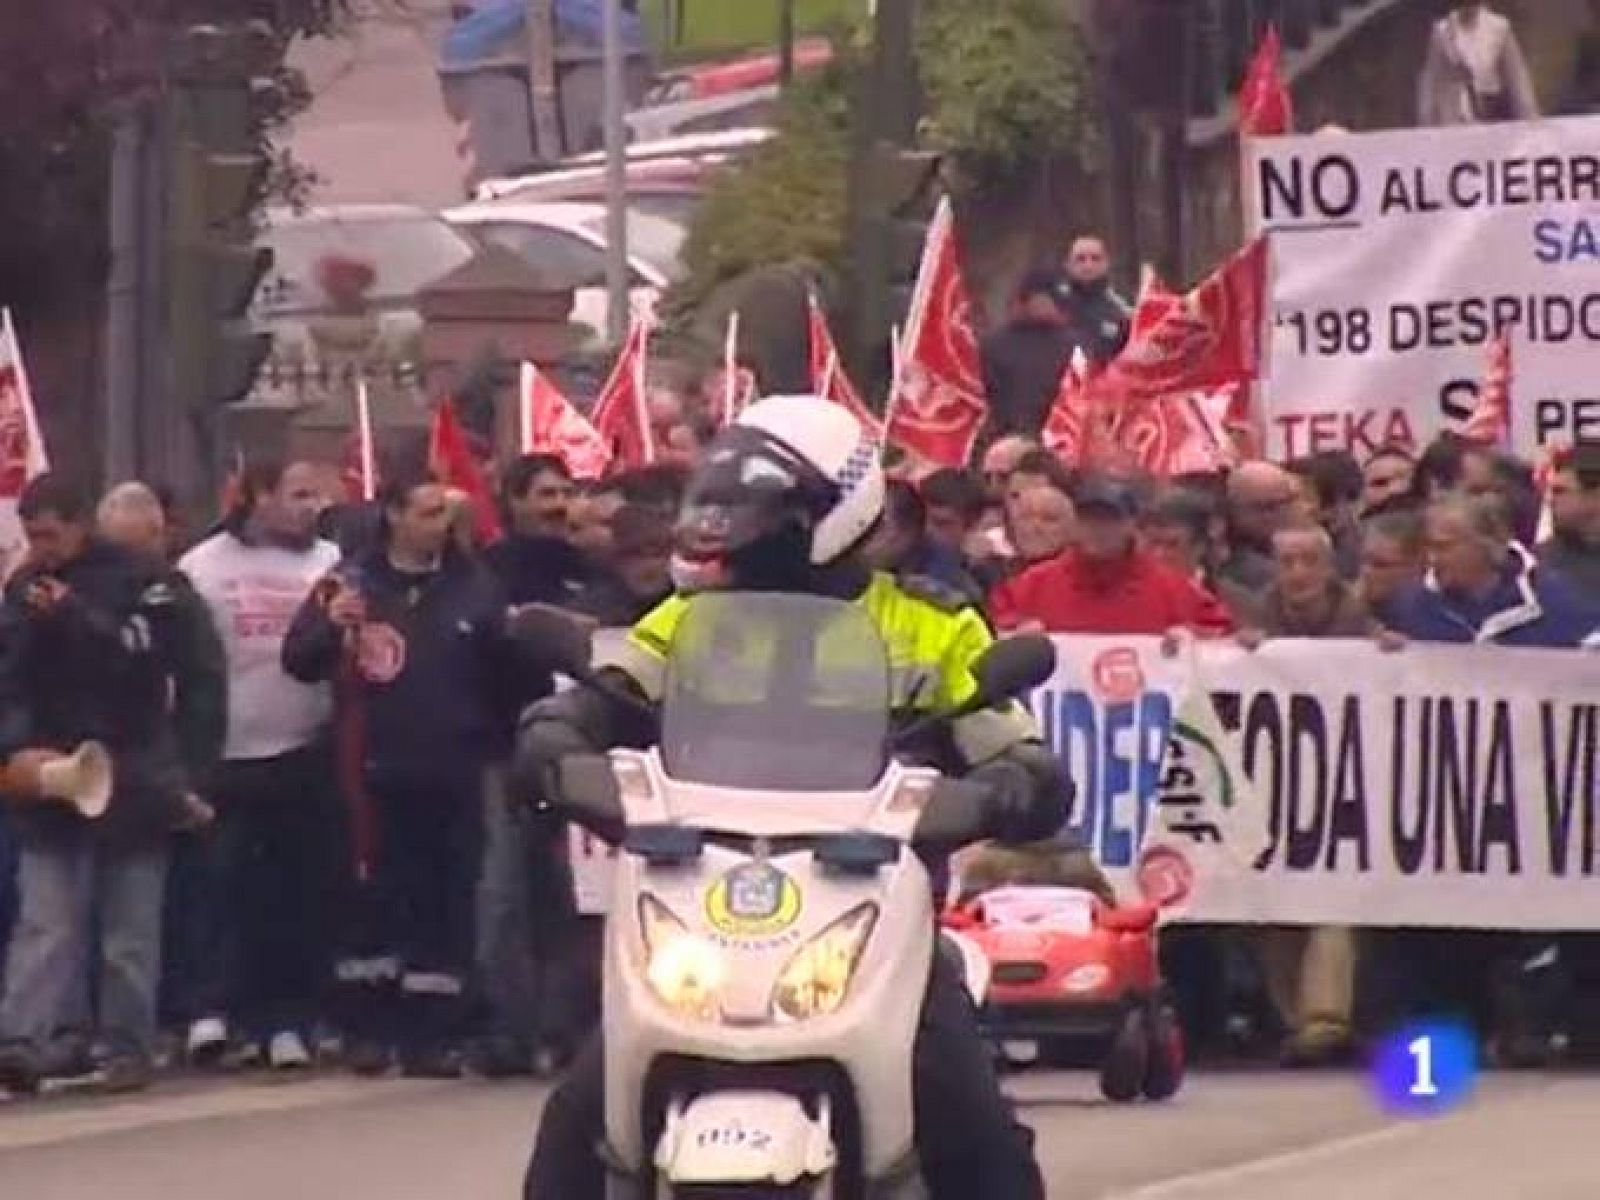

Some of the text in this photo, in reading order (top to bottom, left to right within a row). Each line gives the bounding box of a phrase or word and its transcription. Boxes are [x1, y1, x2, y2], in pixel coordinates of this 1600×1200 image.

[1260, 154, 1359, 219] NO
[1534, 220, 1600, 263] SA
[1276, 409, 1416, 461] TEKA
[1393, 696, 1521, 874] UNA
